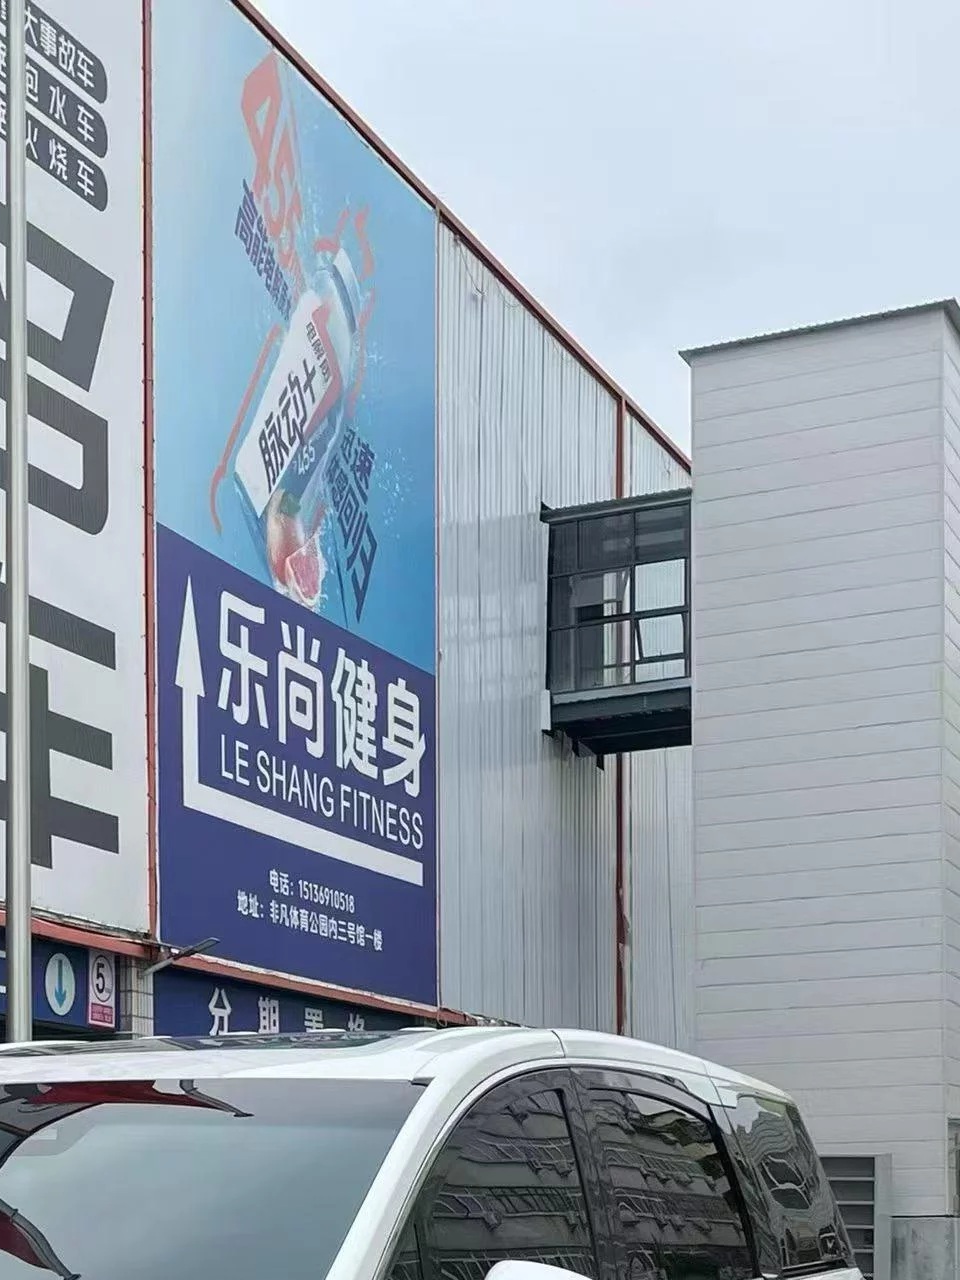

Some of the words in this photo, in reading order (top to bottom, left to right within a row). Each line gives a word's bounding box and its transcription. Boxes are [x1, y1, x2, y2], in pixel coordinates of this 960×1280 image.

[217, 590, 426, 798] 乐尚健身
[221, 733, 250, 787] LE
[256, 750, 335, 818] SHANG
[341, 783, 424, 850] FITNESS
